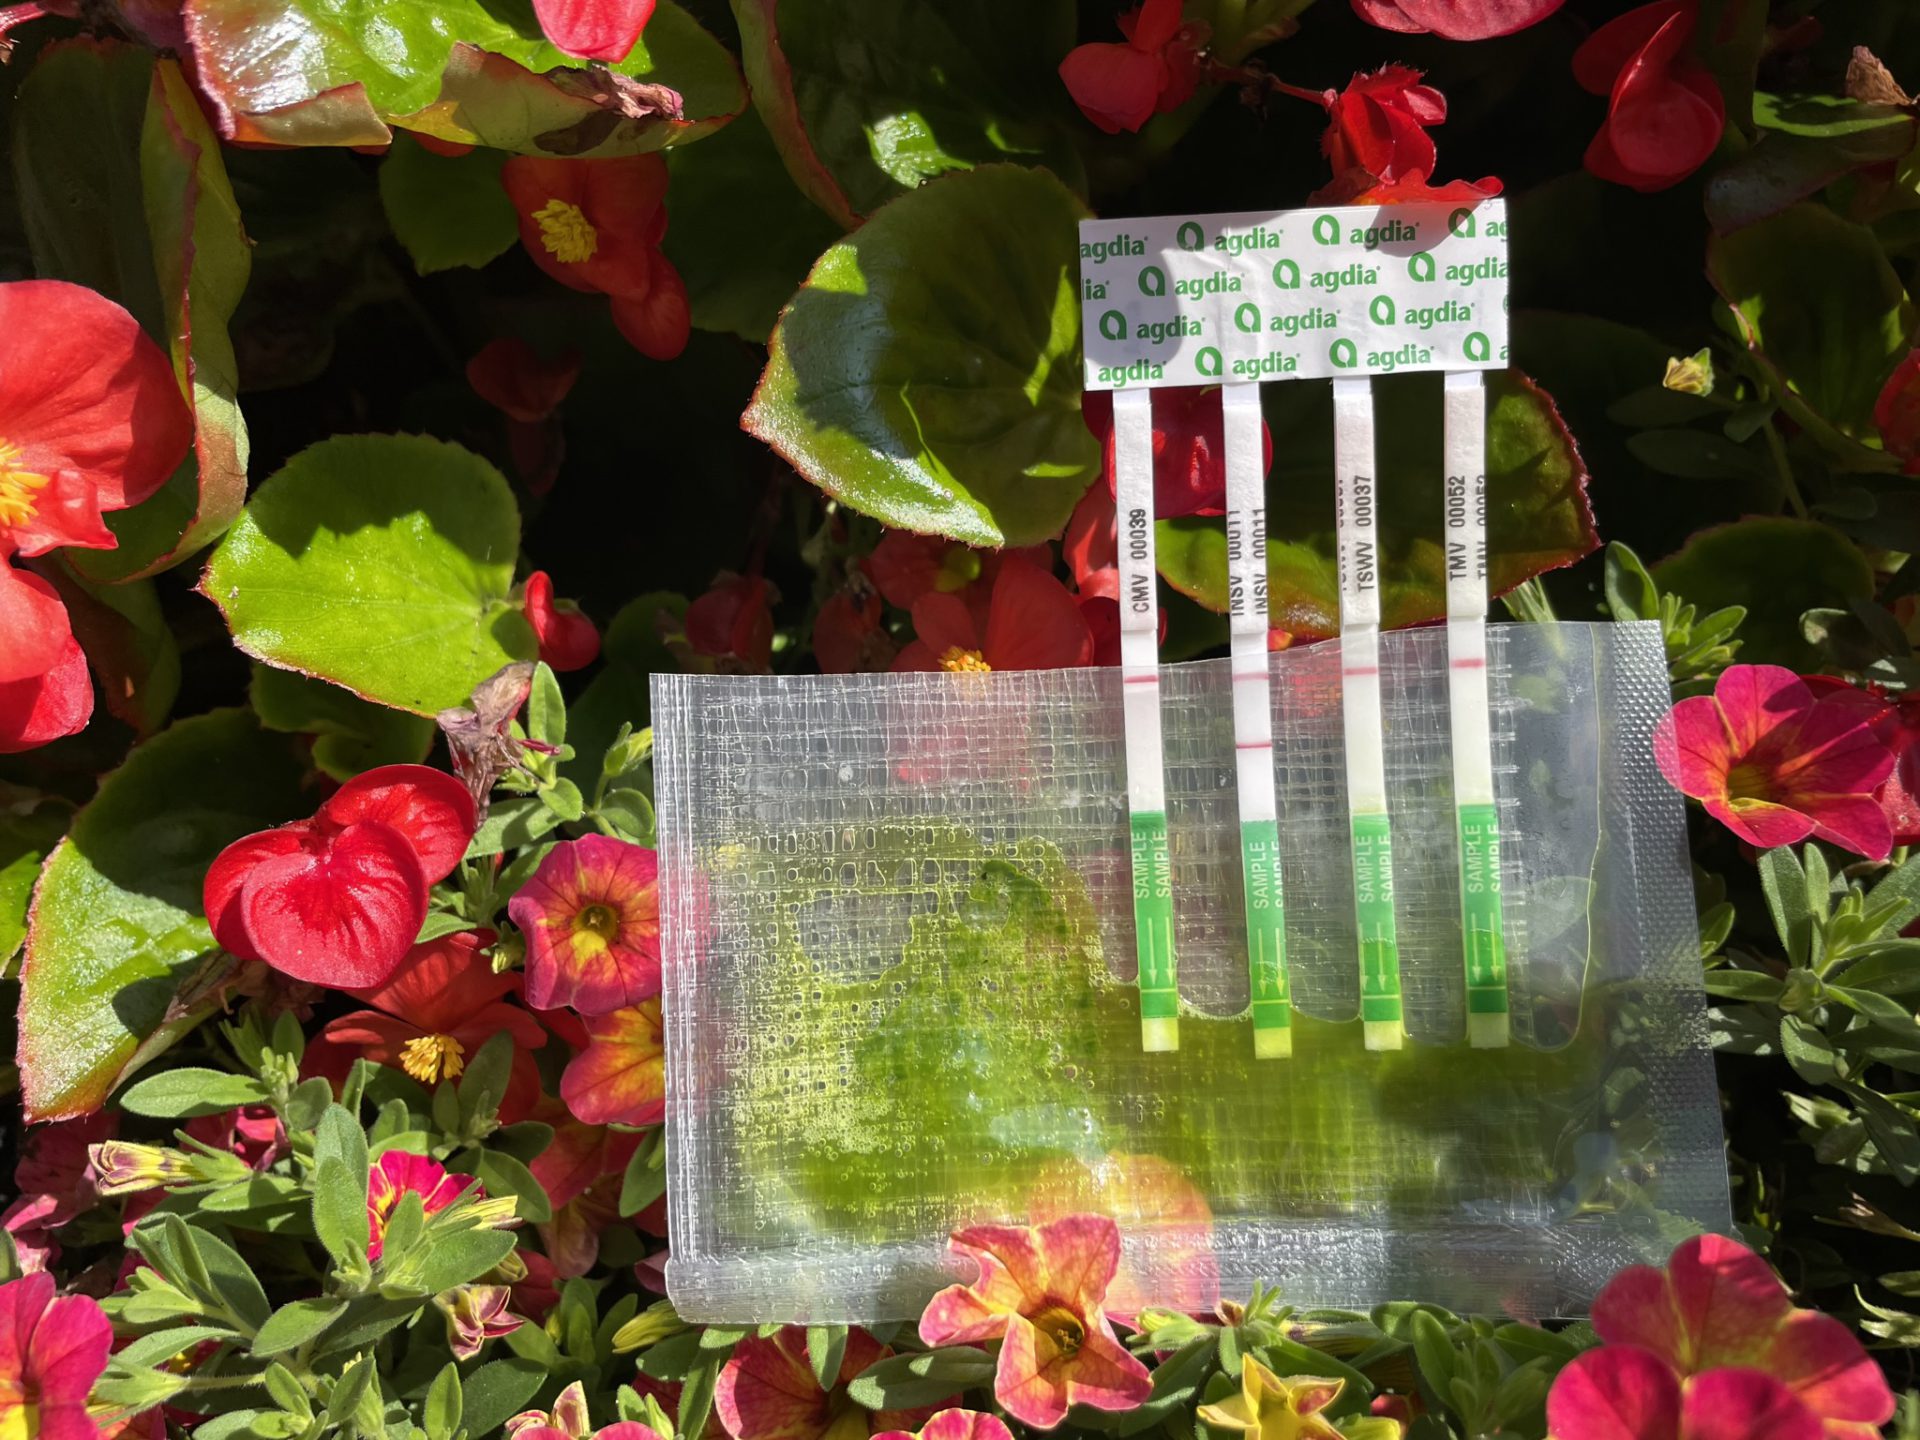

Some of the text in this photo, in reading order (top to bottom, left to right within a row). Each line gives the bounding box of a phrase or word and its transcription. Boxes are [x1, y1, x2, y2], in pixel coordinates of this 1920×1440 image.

[1080, 234, 1145, 265] agdia
[1214, 227, 1281, 257] agdia
[1350, 220, 1416, 252] agdia
[1082, 278, 1106, 300] ia
[1174, 271, 1241, 301] agdia
[1310, 263, 1377, 293] agdia
[1136, 315, 1202, 345] agdia
[1270, 307, 1337, 337] agdia
[1405, 300, 1471, 330] agdia
[1098, 358, 1164, 388] agdia
[1232, 351, 1297, 380] agdia
[1367, 344, 1431, 372] agdia
[1354, 475, 1374, 592] TSWV 00037
[1448, 475, 1467, 581] TMV 00052
[1129, 508, 1149, 613] CMV 00039
[1230, 575, 1244, 616] INSV
[1253, 573, 1267, 615] INSV
[1131, 832, 1150, 899] SAMPLE
[1152, 831, 1171, 898] SAMPLE
[1355, 834, 1374, 903] SAMPLE
[1464, 824, 1484, 893] SAMPLE
[1250, 840, 1269, 909] SAMPLE
